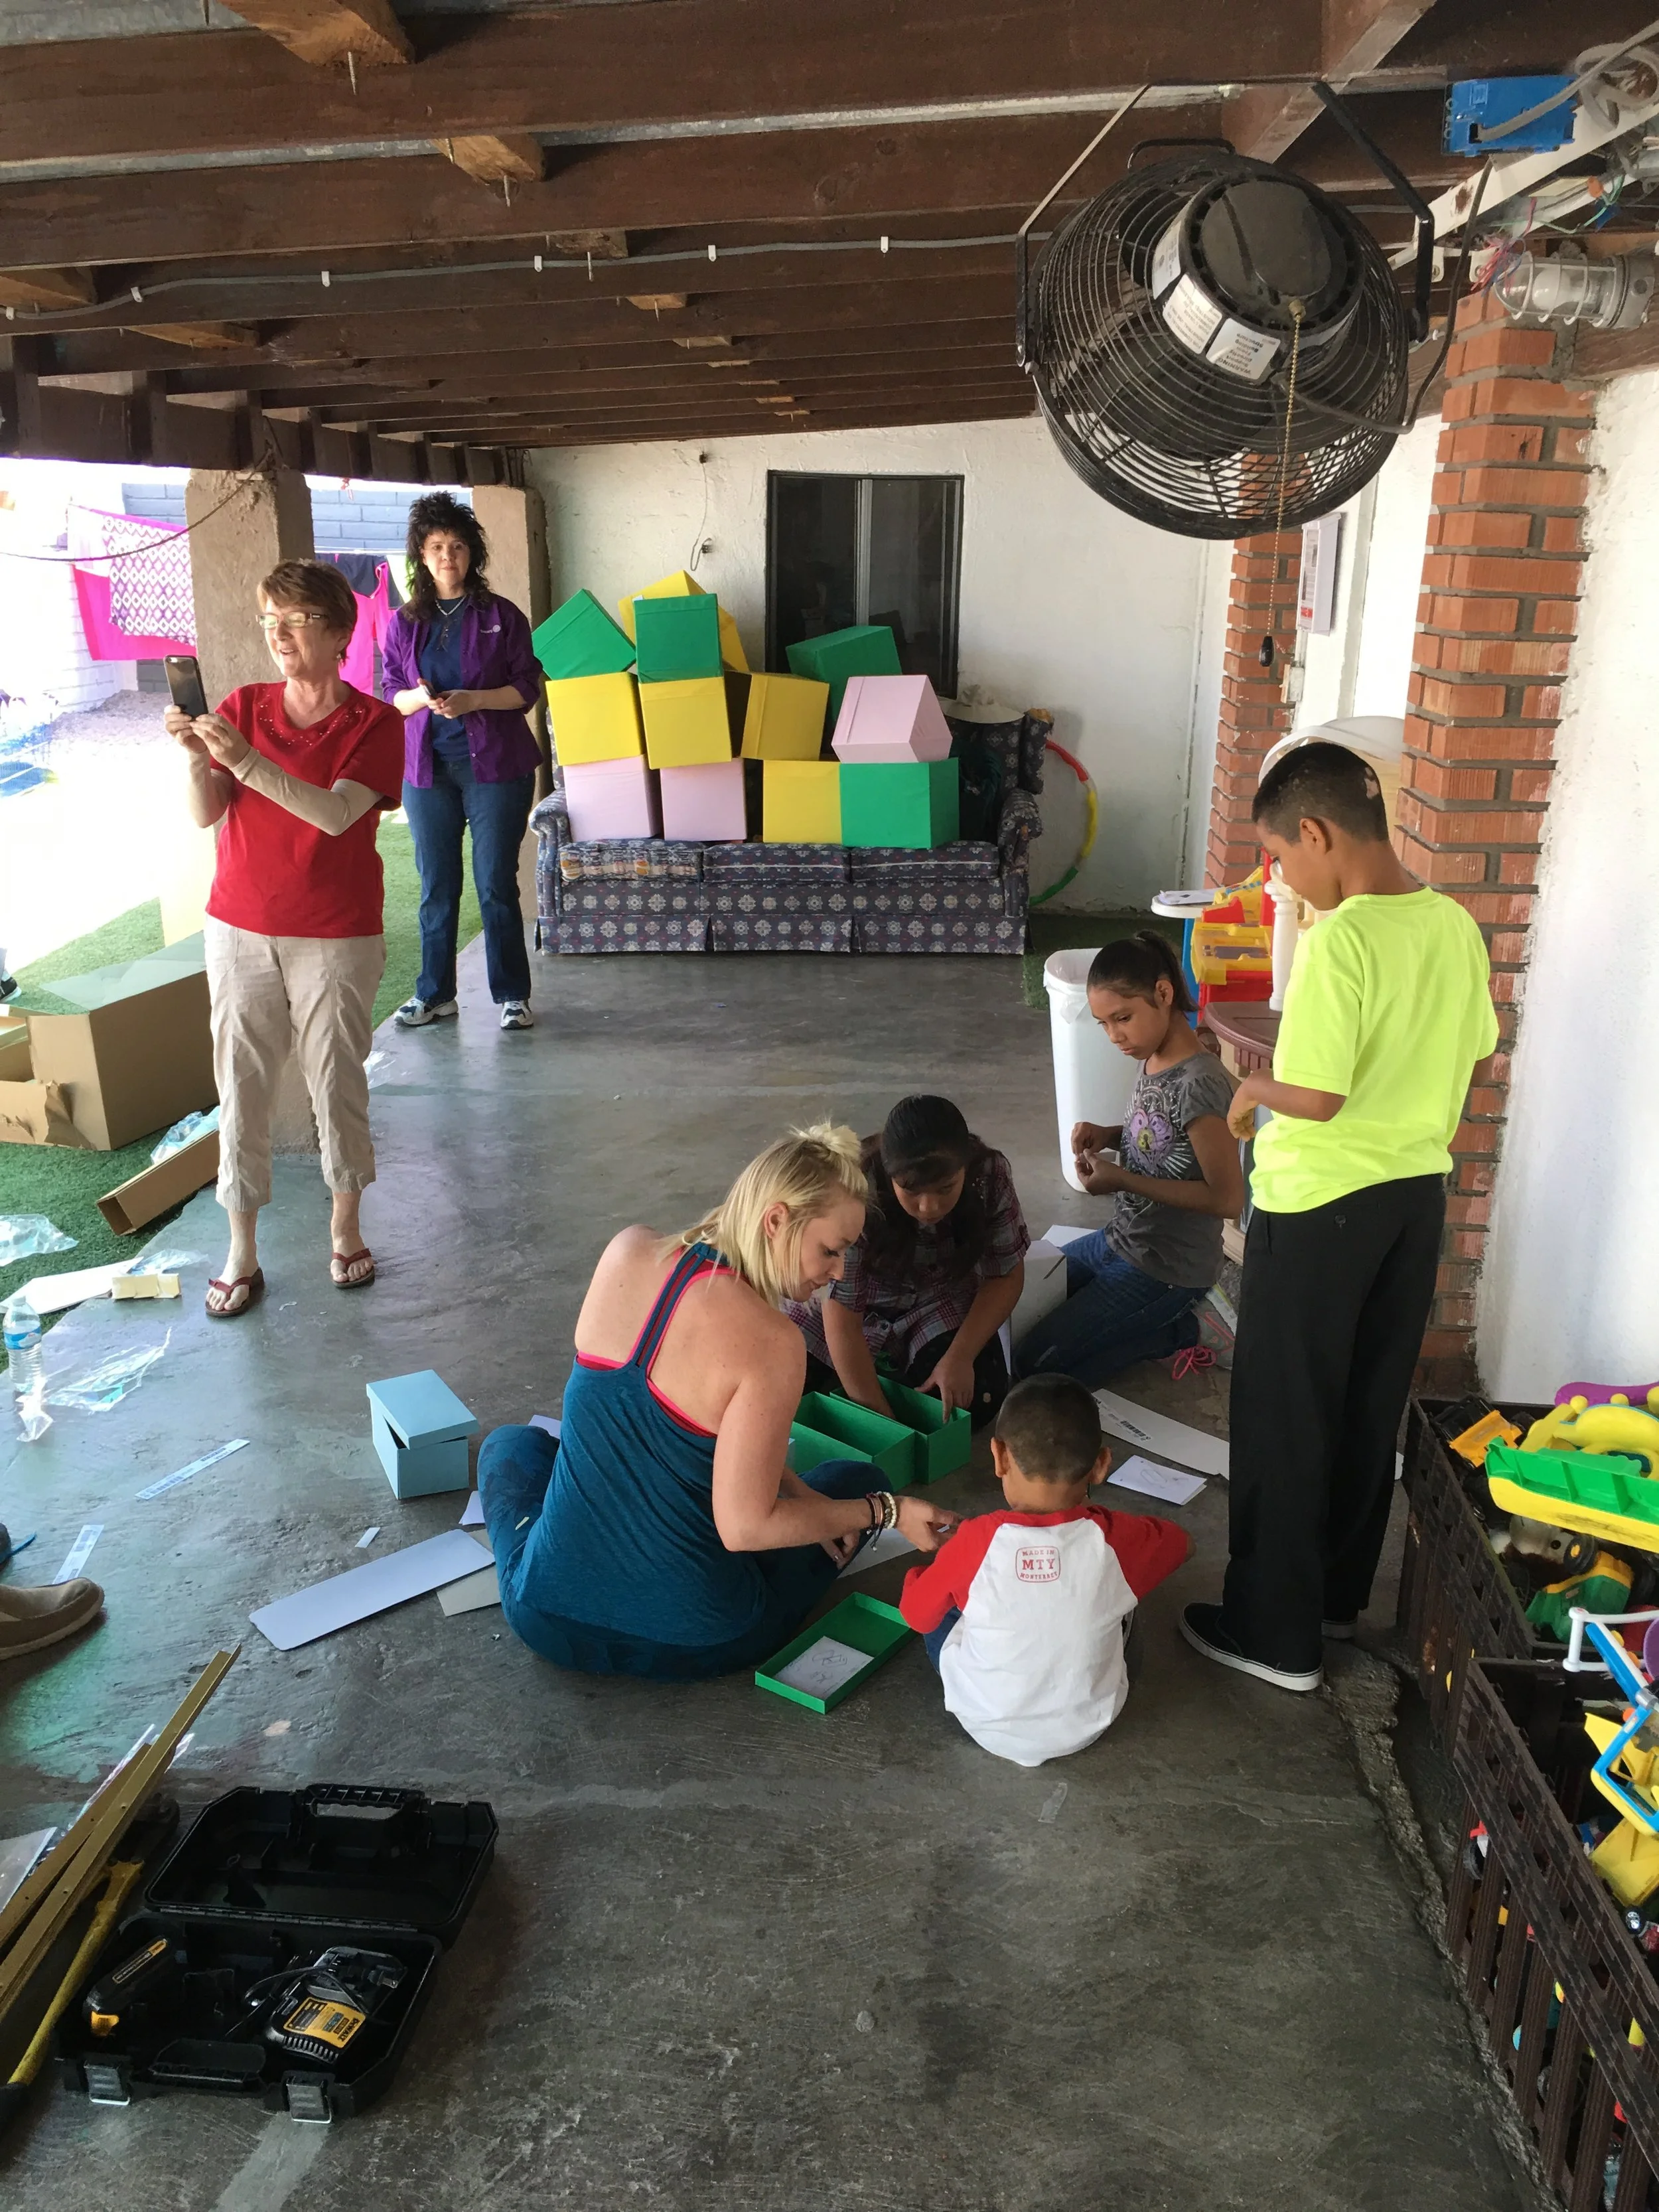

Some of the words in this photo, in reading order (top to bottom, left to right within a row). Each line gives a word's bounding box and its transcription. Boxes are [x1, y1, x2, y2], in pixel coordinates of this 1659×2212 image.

[1218, 358, 1251, 374] WARNING
[1022, 1558, 1055, 1570] MTY
[1019, 1571, 1057, 1580] MONTERREY
